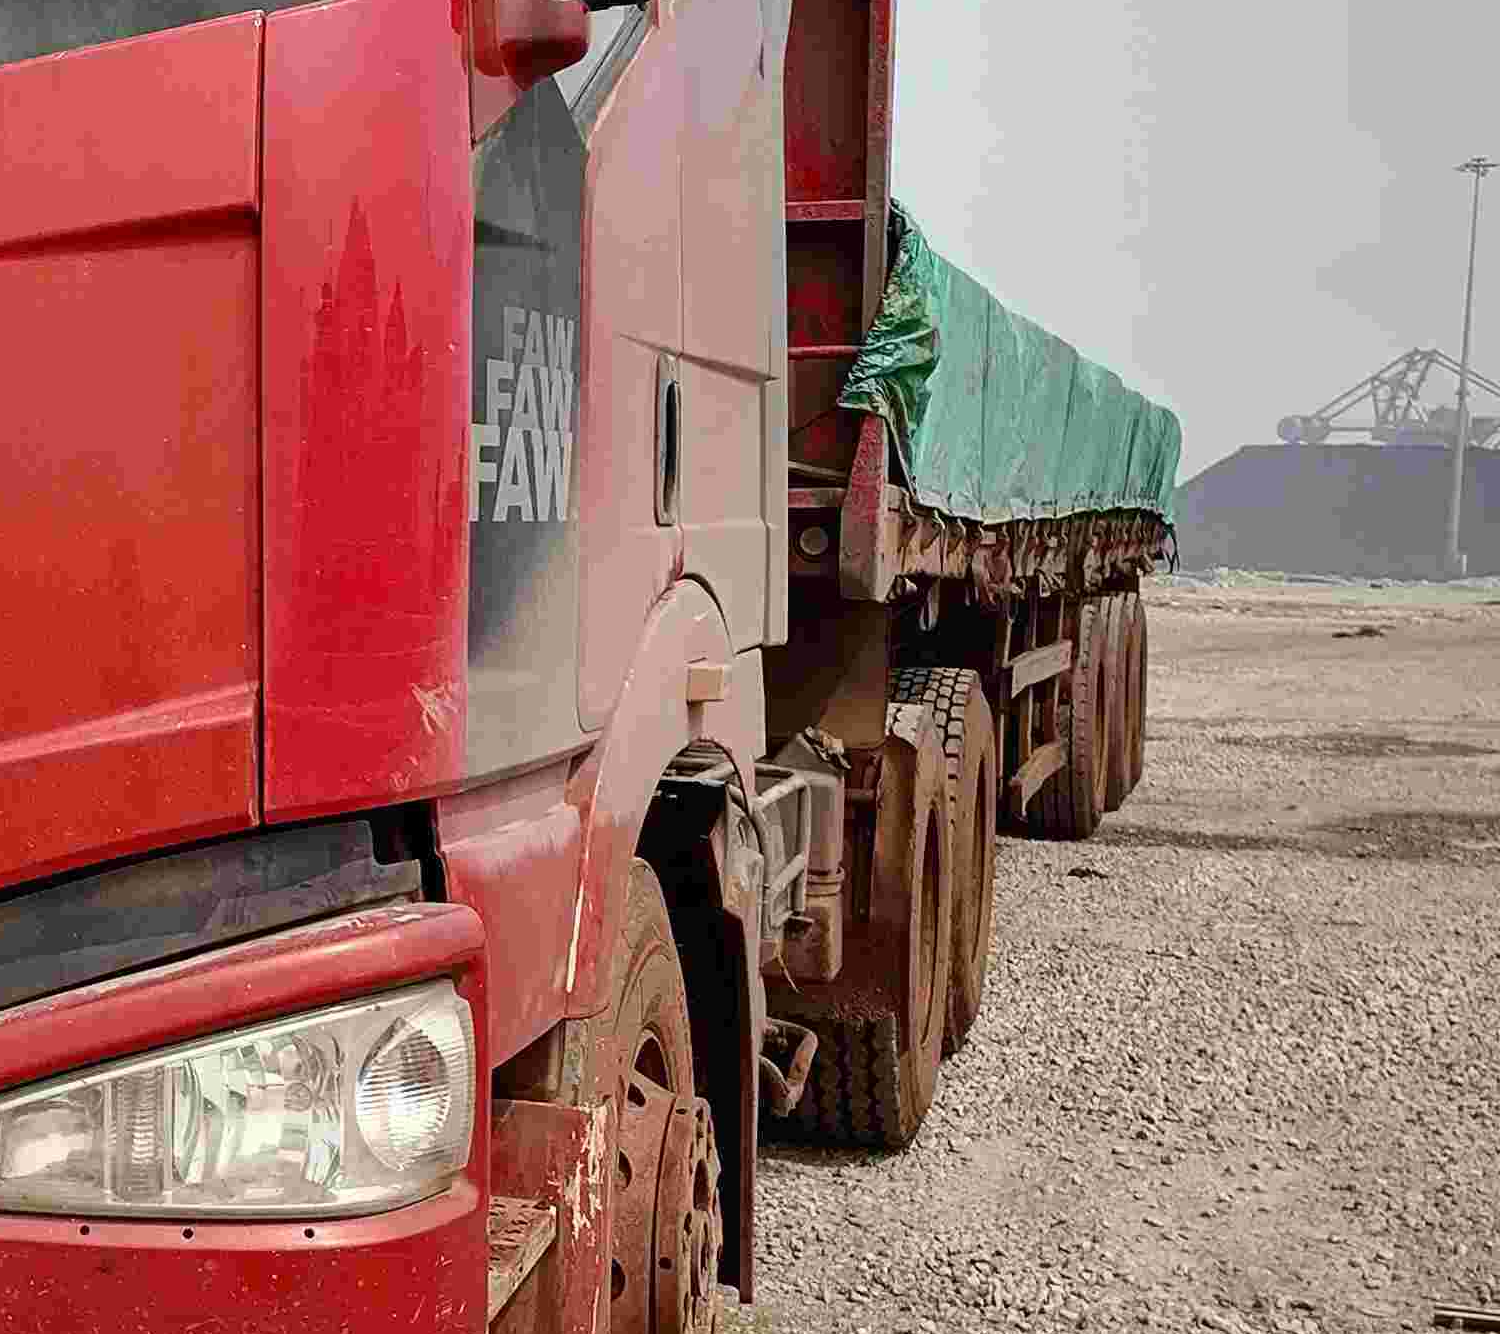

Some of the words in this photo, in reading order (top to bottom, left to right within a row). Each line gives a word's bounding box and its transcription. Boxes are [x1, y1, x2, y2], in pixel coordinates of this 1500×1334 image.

[503, 306, 575, 367] FAW
[486, 358, 575, 432] FAW
[470, 423, 572, 522] FAW
